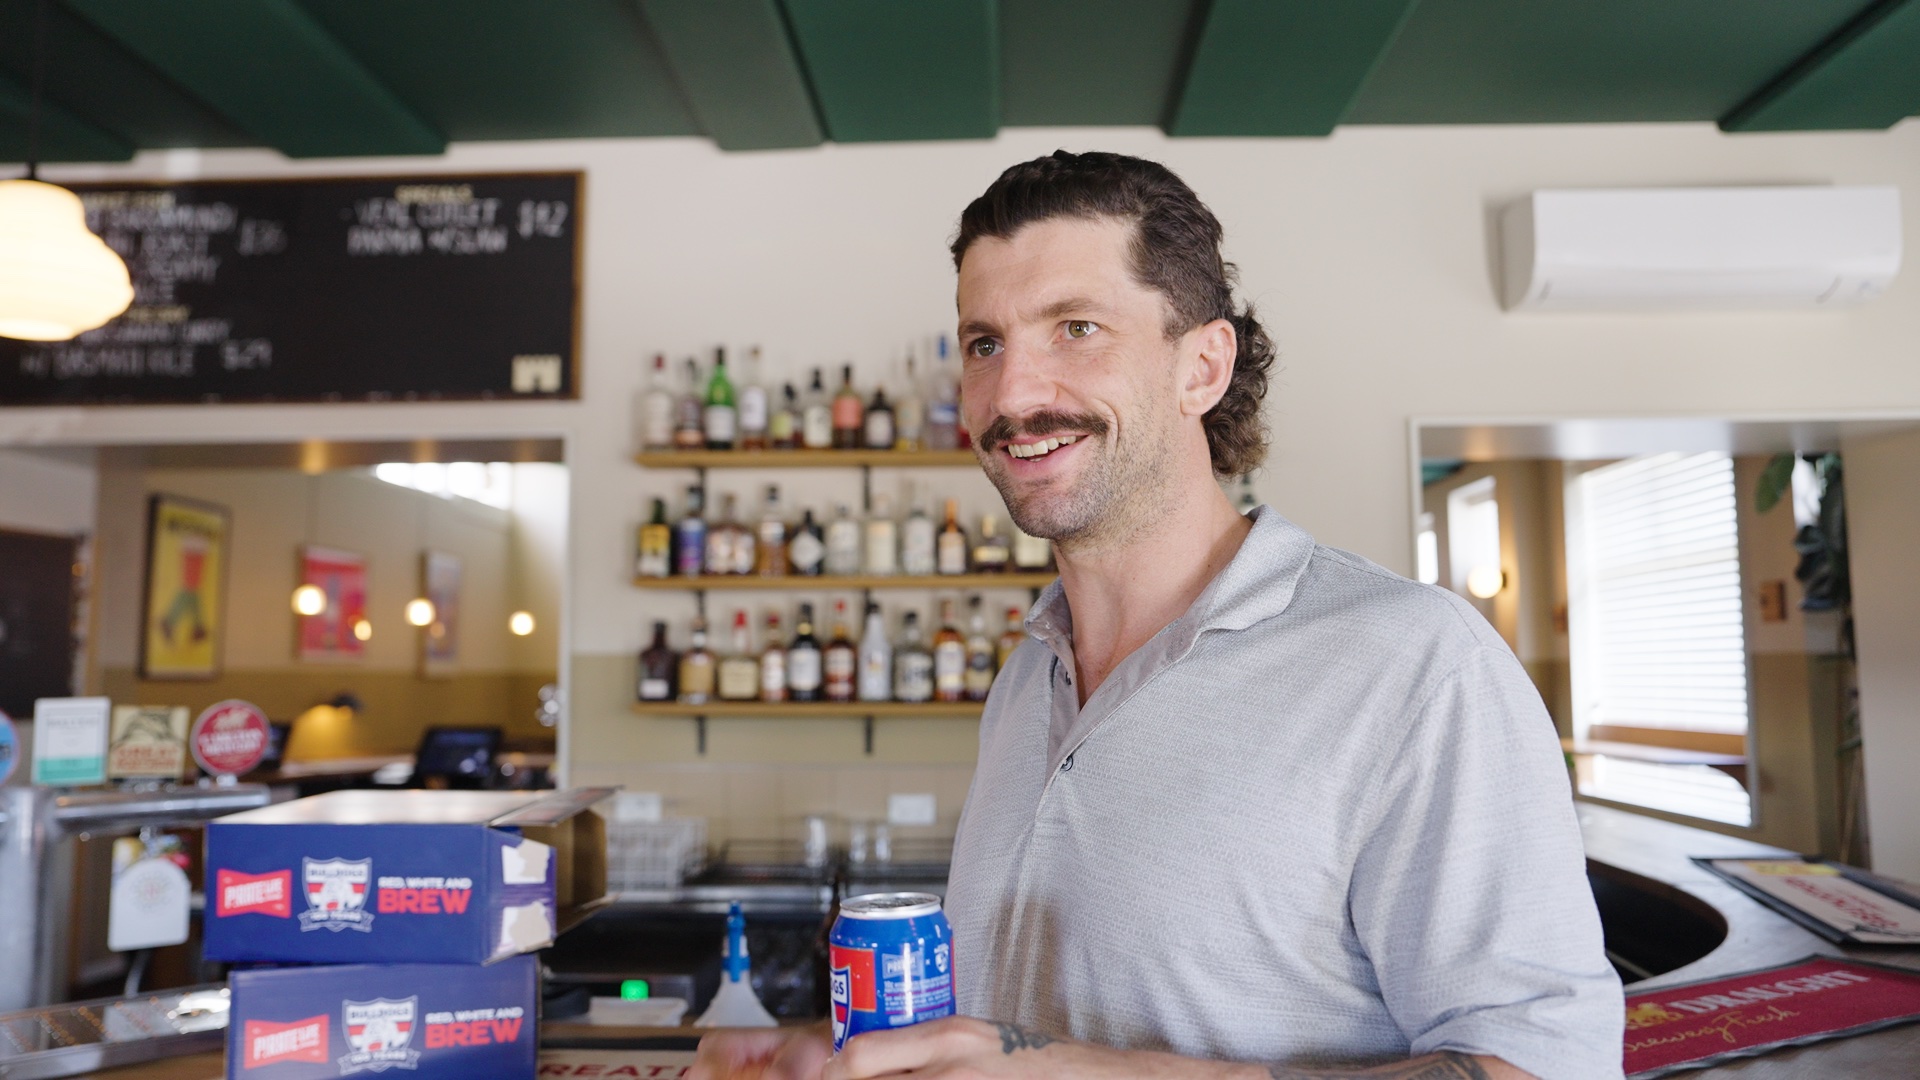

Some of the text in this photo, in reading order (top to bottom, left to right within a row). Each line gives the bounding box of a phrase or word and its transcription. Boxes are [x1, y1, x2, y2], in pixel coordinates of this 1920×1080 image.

[406, 877, 446, 889] WHITE
[444, 877, 473, 889] AND
[378, 888, 473, 914] BREW
[1666, 970, 1873, 1013] DRAUGHT
[454, 1008, 496, 1023] WHITE
[495, 1006, 524, 1020] AND
[1624, 1005, 1801, 1052] rewery Fresh
[425, 1018, 524, 1049] BREW
